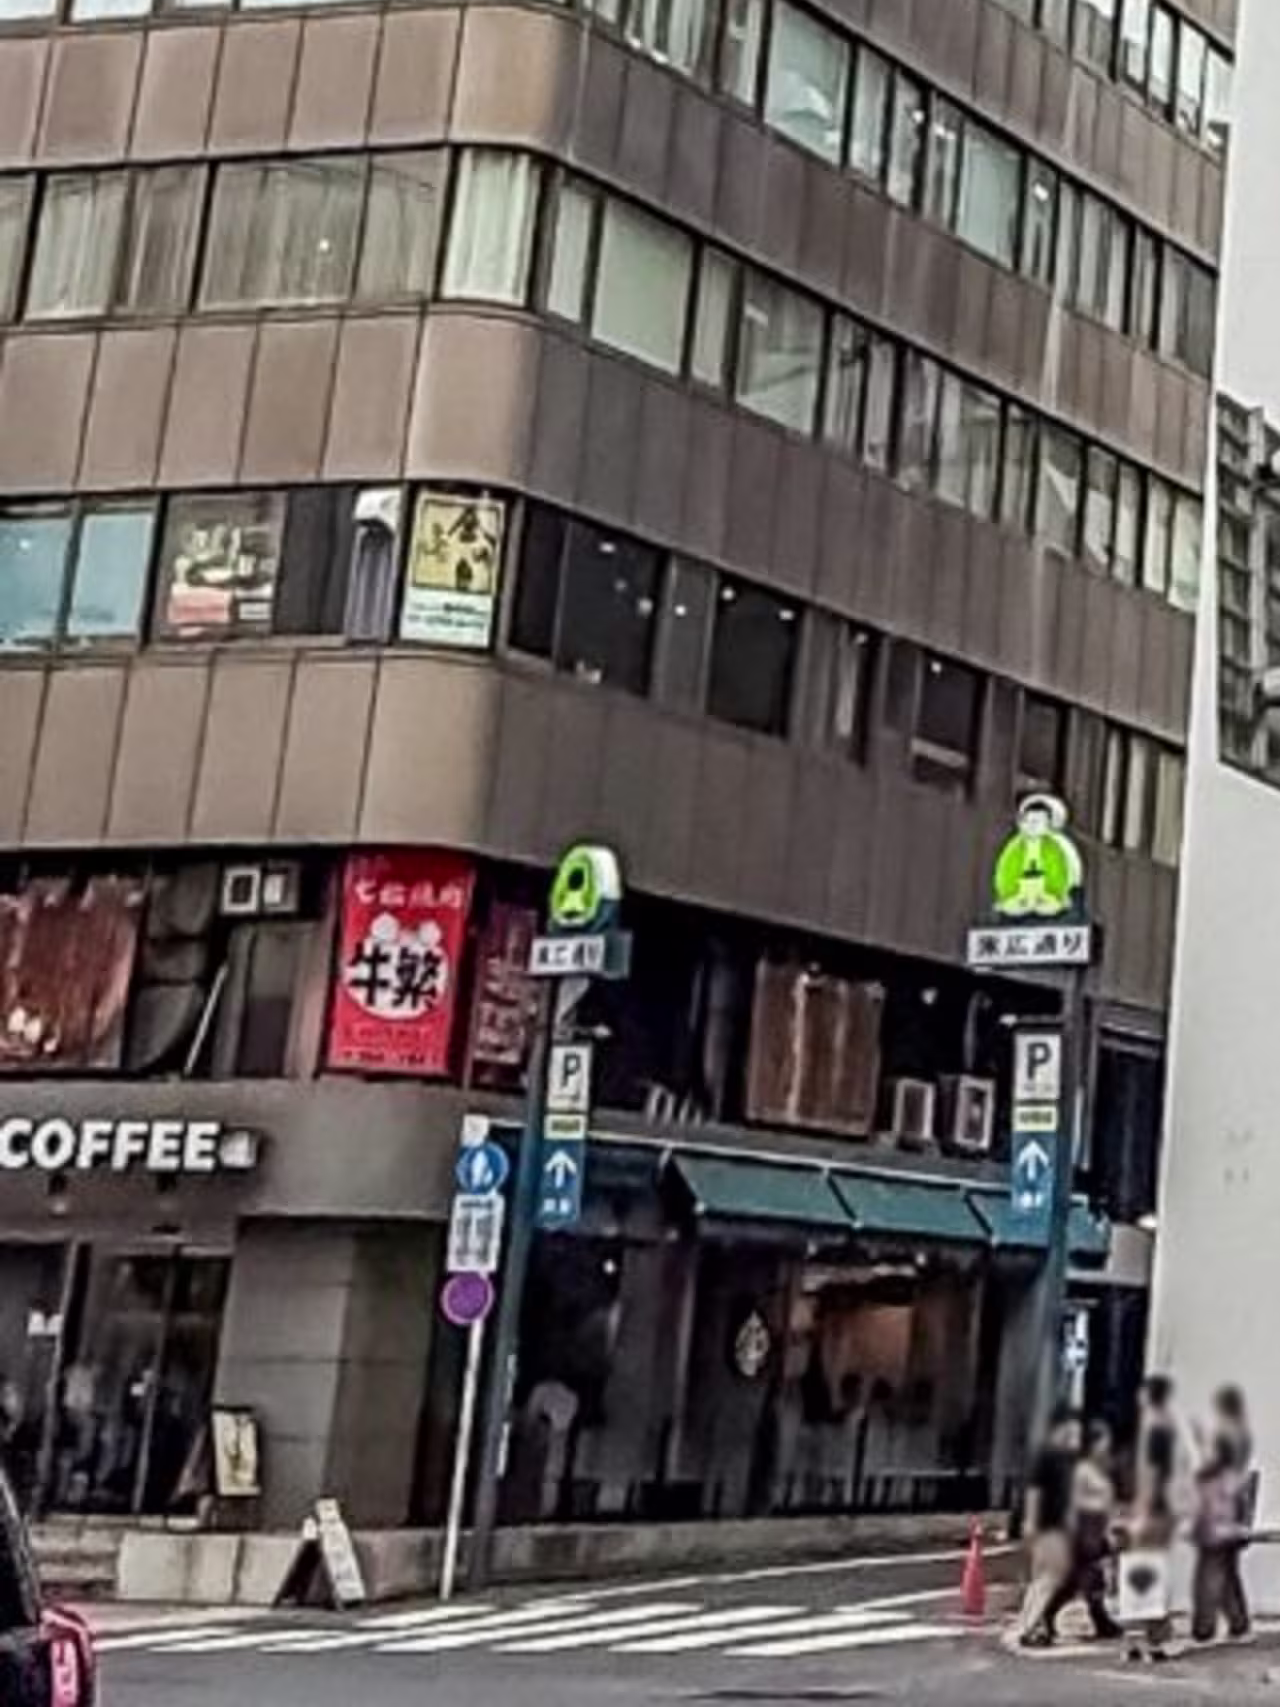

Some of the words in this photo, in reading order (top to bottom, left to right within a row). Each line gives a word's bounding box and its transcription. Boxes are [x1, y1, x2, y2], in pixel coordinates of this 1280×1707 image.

[562, 1052, 581, 1087] P
[1027, 1042, 1053, 1079] P
[0, 1118, 220, 1172] COFFEE
